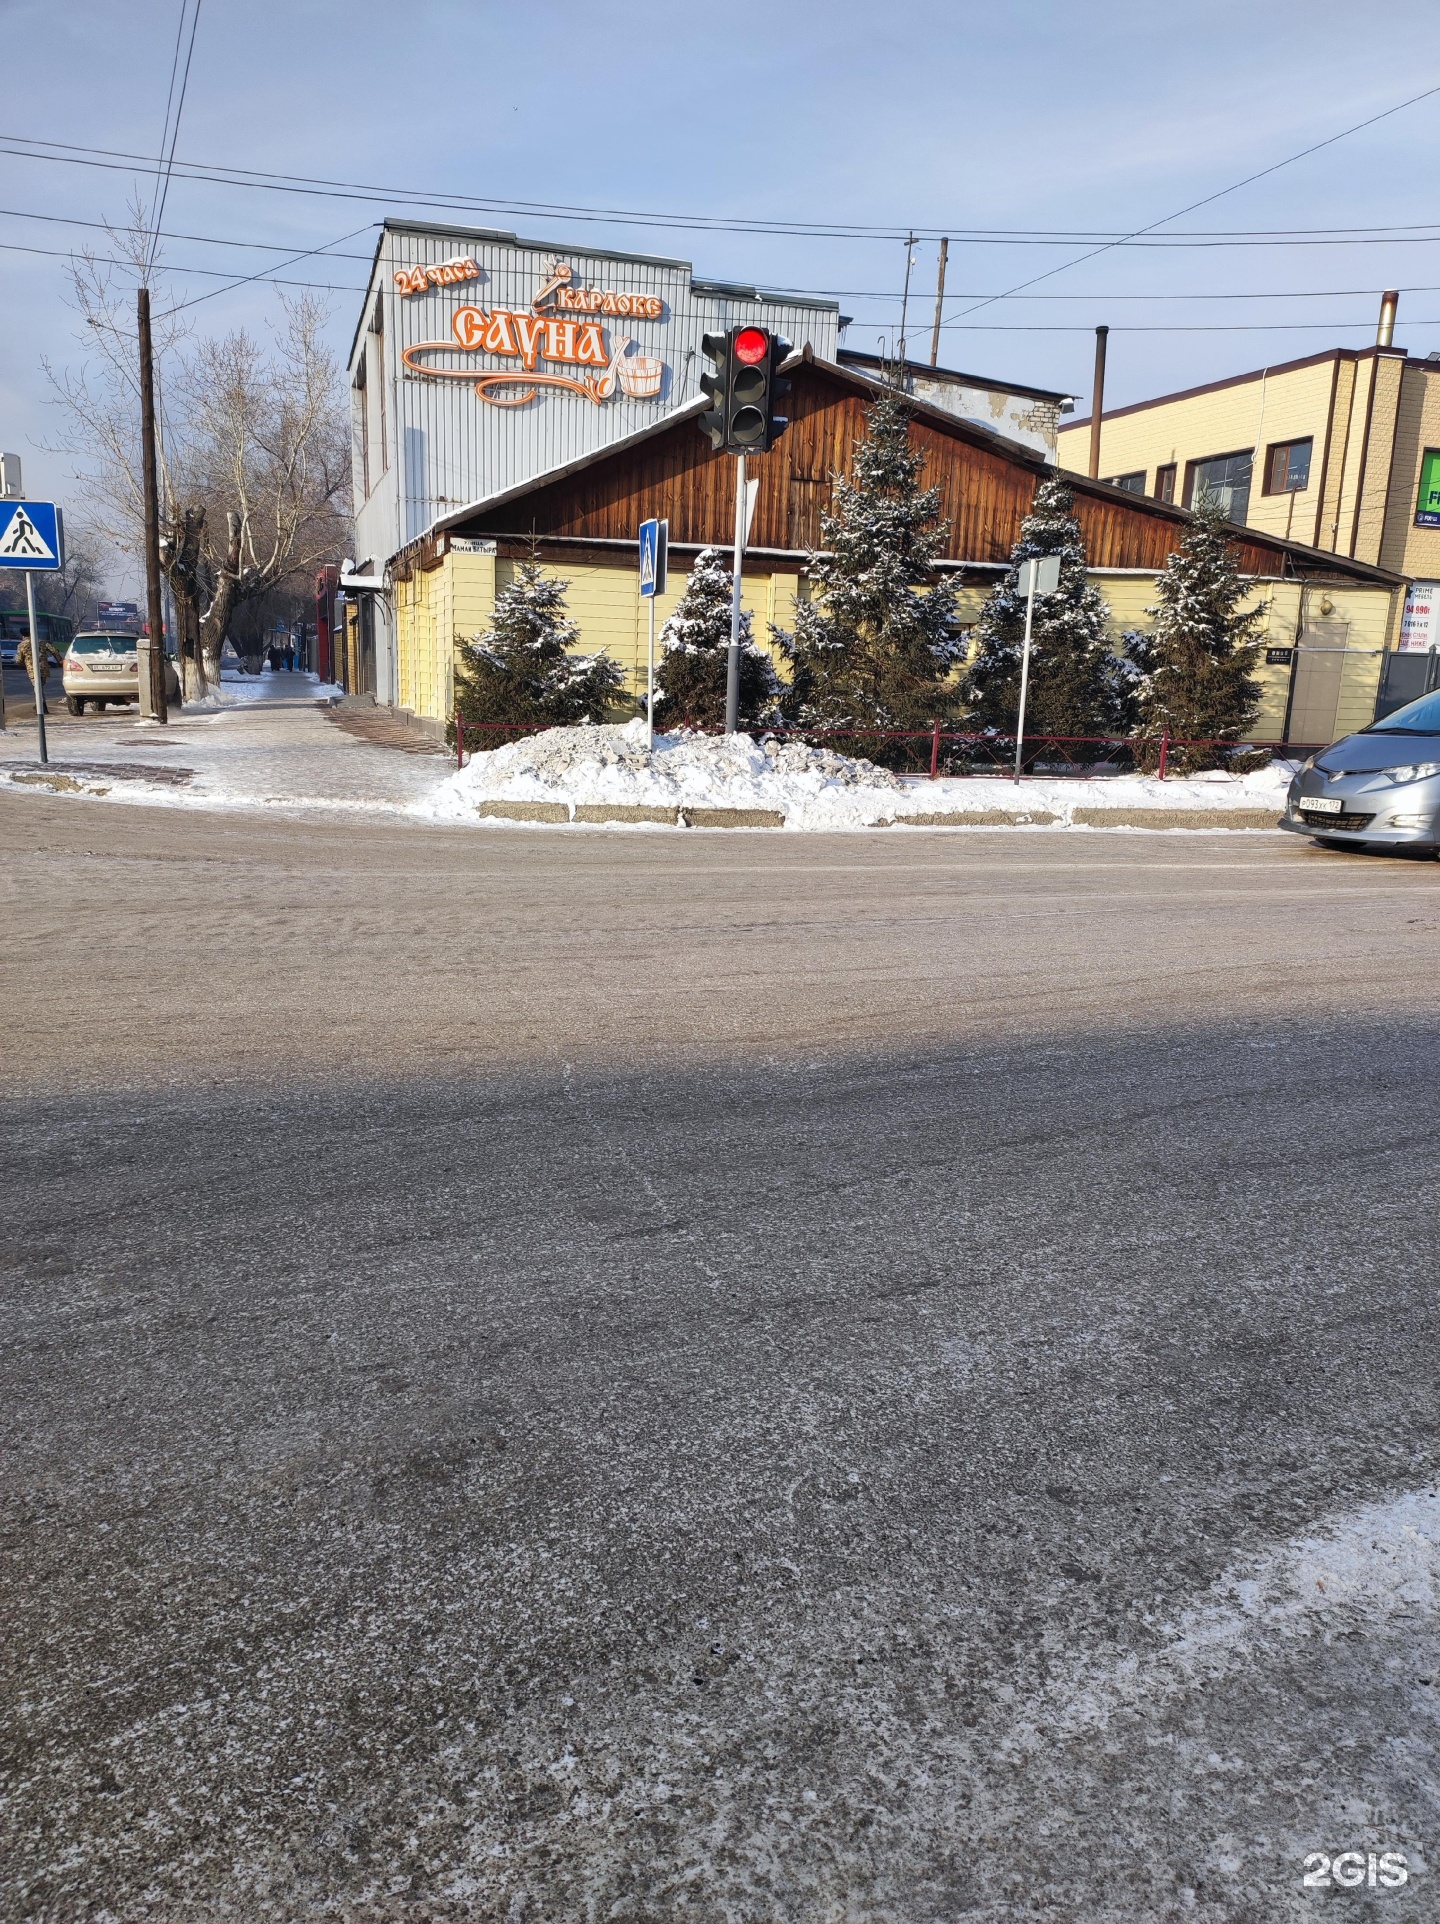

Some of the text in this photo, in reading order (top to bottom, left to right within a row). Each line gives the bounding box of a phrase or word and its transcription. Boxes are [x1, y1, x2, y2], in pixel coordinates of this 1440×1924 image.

[394, 259, 480, 297] 24 часа
[557, 287, 662, 319] КАРАОКЕ
[453, 306, 608, 369] САУНА
[1415, 587, 1433, 595] PRIME
